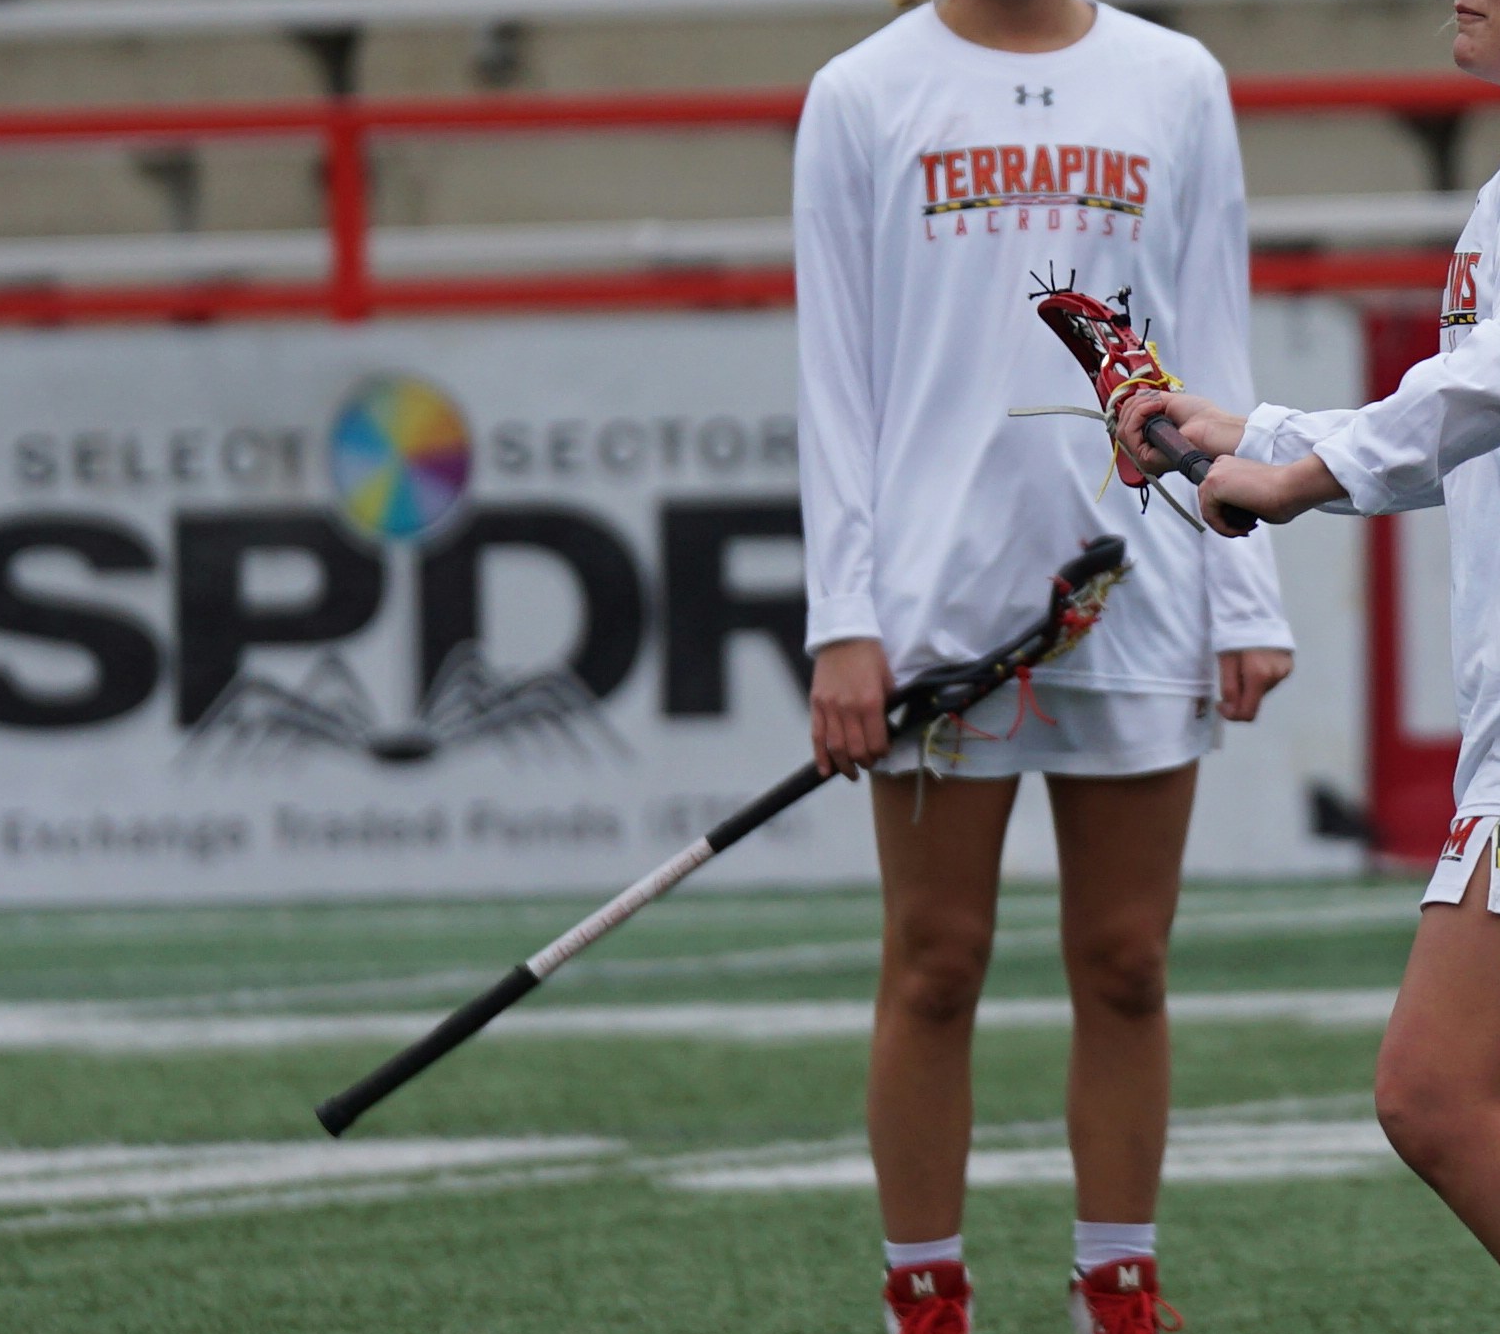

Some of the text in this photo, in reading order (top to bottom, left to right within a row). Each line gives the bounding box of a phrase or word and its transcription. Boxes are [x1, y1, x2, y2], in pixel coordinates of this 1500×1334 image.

[919, 144, 1150, 205] TERRAPINS
[923, 208, 1142, 242] LACROSSE
[12, 413, 800, 490] SELECT SECTOR
[910, 1270, 936, 1297] M
[1118, 1264, 1141, 1289] M
